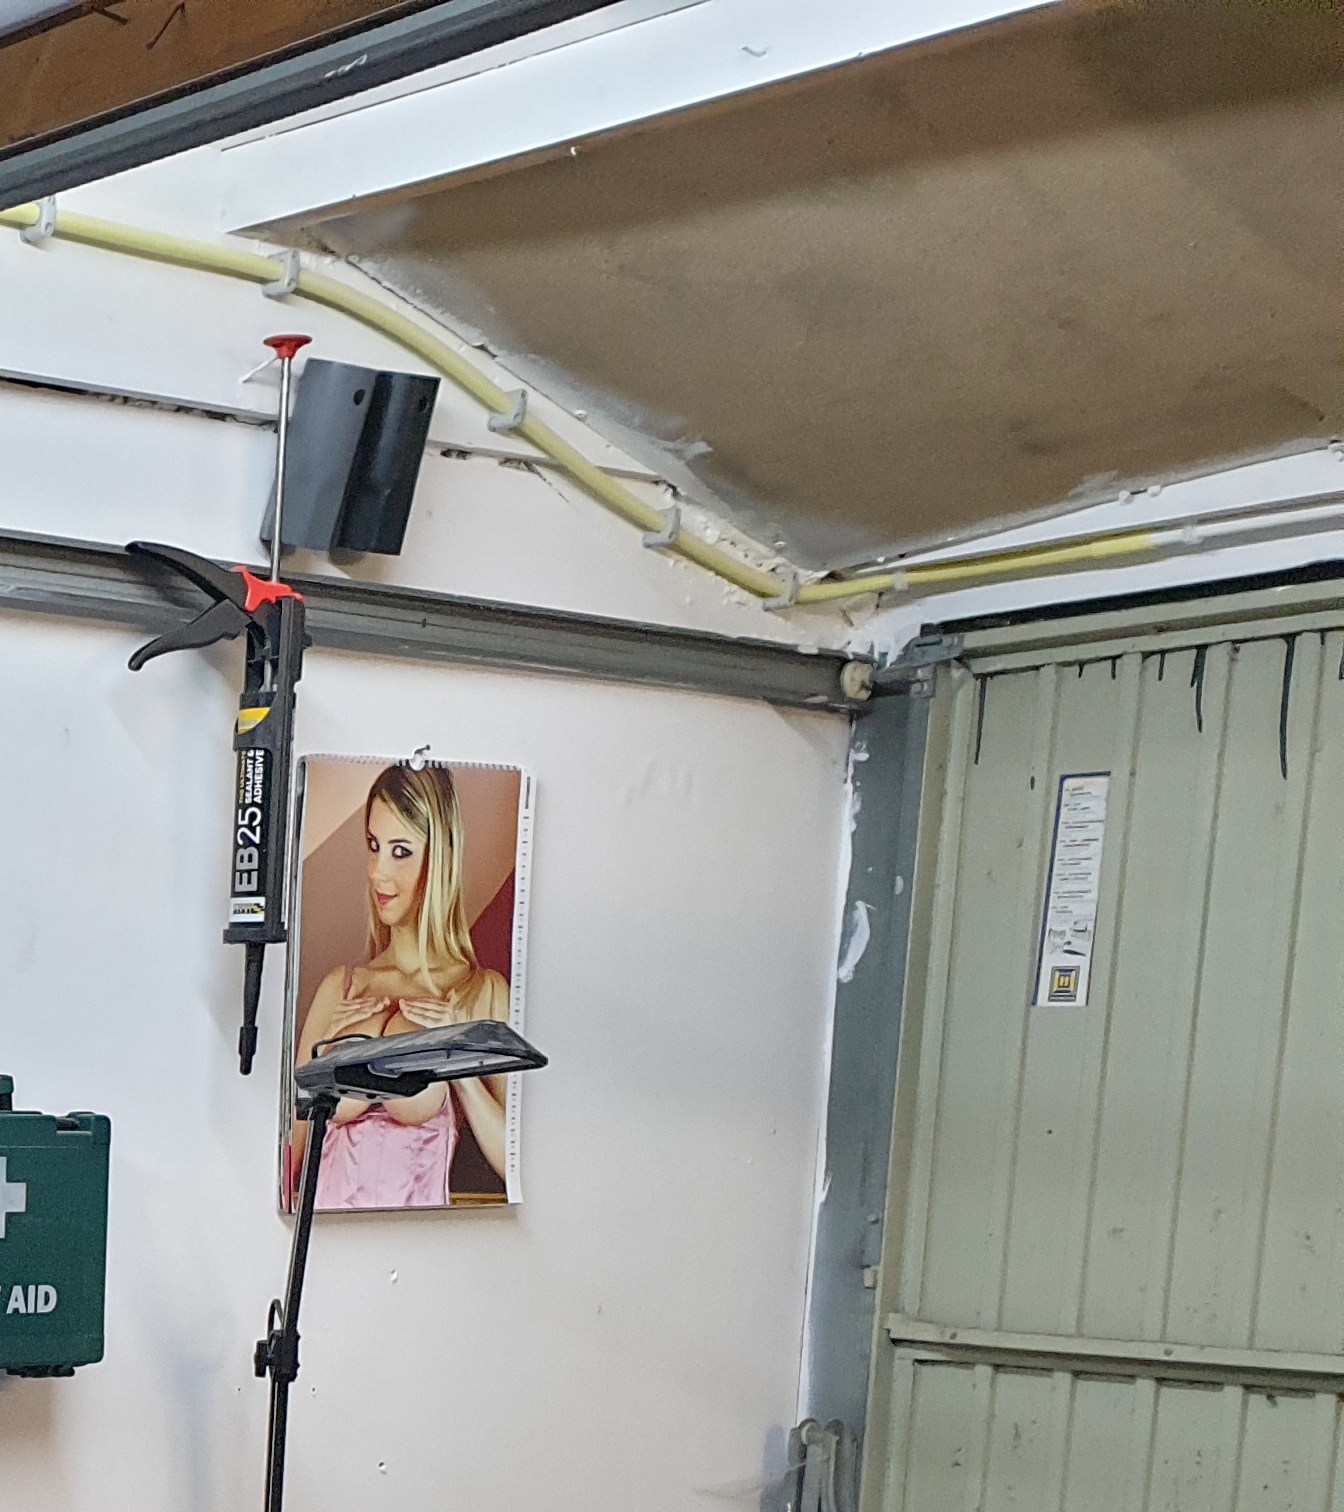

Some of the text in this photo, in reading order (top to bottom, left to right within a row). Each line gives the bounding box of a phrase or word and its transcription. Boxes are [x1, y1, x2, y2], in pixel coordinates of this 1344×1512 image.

[244, 758, 254, 804] SEALANT
[253, 749, 265, 804] ADHESIVE
[234, 806, 263, 893] EB25
[6, 1284, 58, 1314] AID
